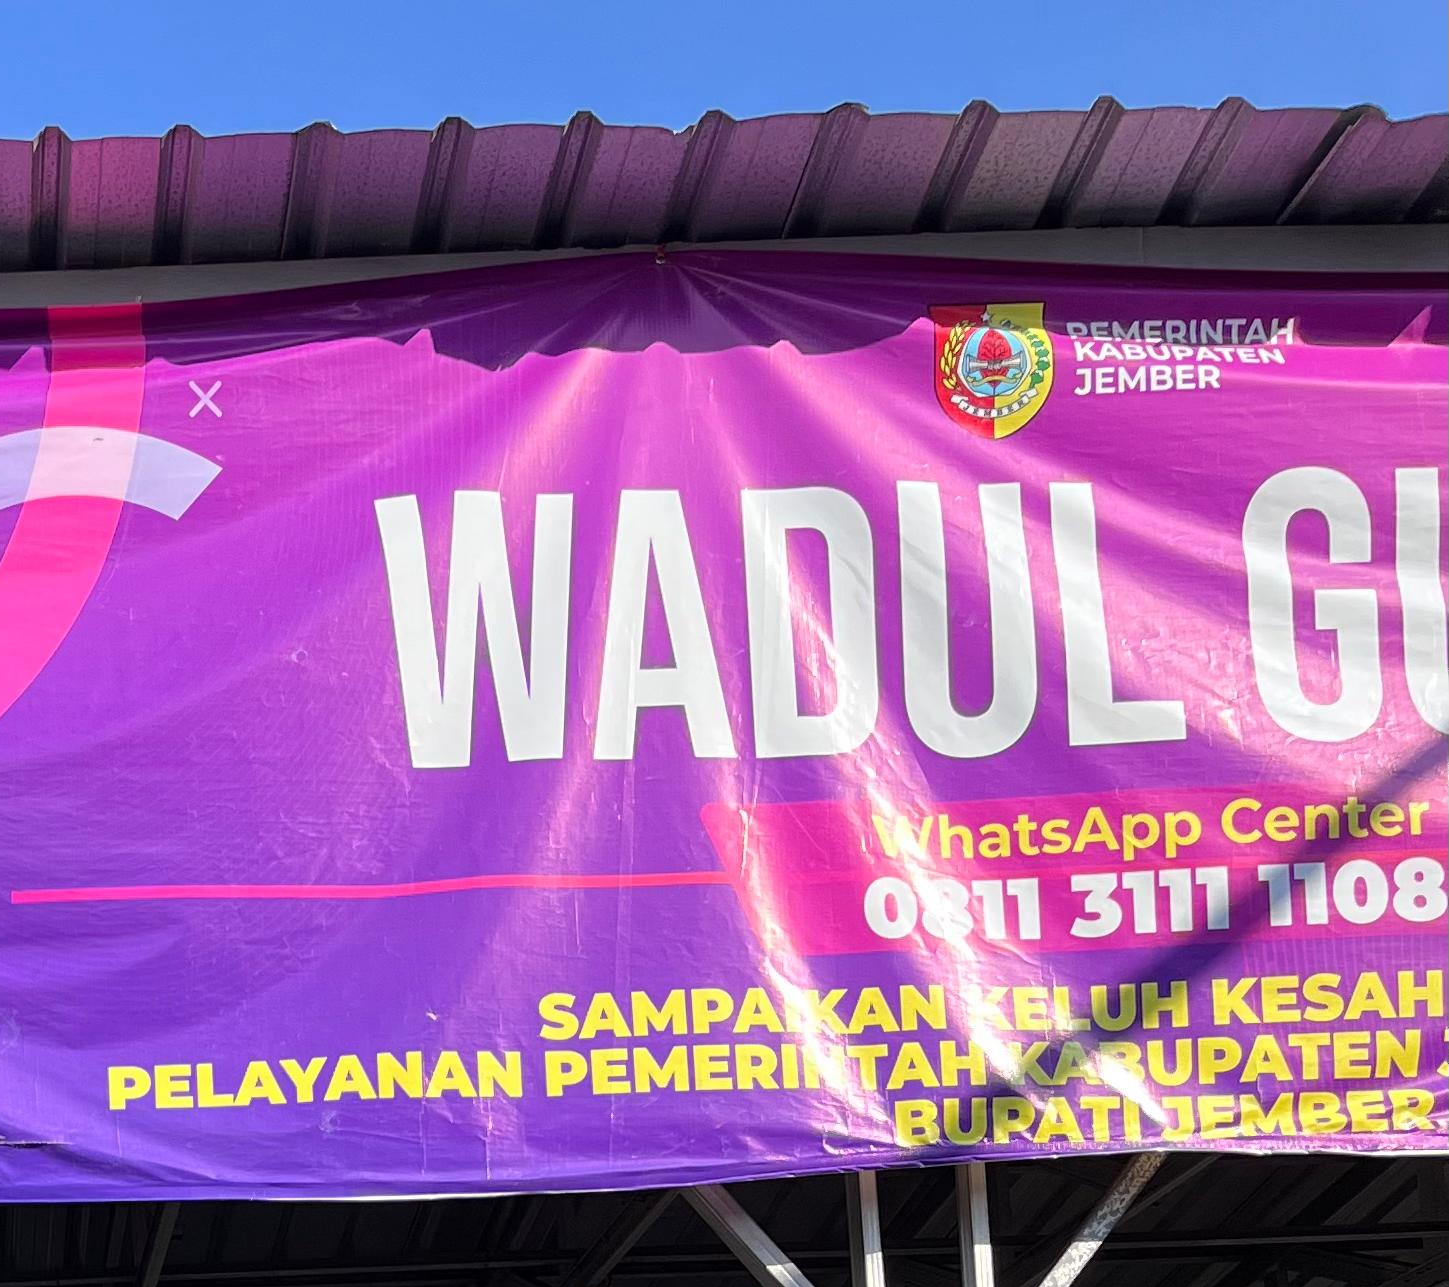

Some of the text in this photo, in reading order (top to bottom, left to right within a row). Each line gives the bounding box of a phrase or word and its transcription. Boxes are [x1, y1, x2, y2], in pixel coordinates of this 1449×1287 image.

[1066, 317, 1294, 345] PEMERINTAH
[1074, 341, 1286, 364] KABUPATEN
[1074, 365, 1221, 395] JEMBER
[374, 480, 1188, 768] WADUL
[872, 797, 1430, 861] WhatsApp Center
[864, 856, 1448, 940] 0811 3111 1108
[538, 969, 1444, 1042] SAMPAIKAN KELUH KESAH
[108, 1050, 523, 1110] PELAYANAN
[544, 1040, 987, 1097] PEMERINTAH
[1008, 1029, 1421, 1088] KABUPATEN
[894, 1089, 1436, 1148] BUPATI JEMBER
